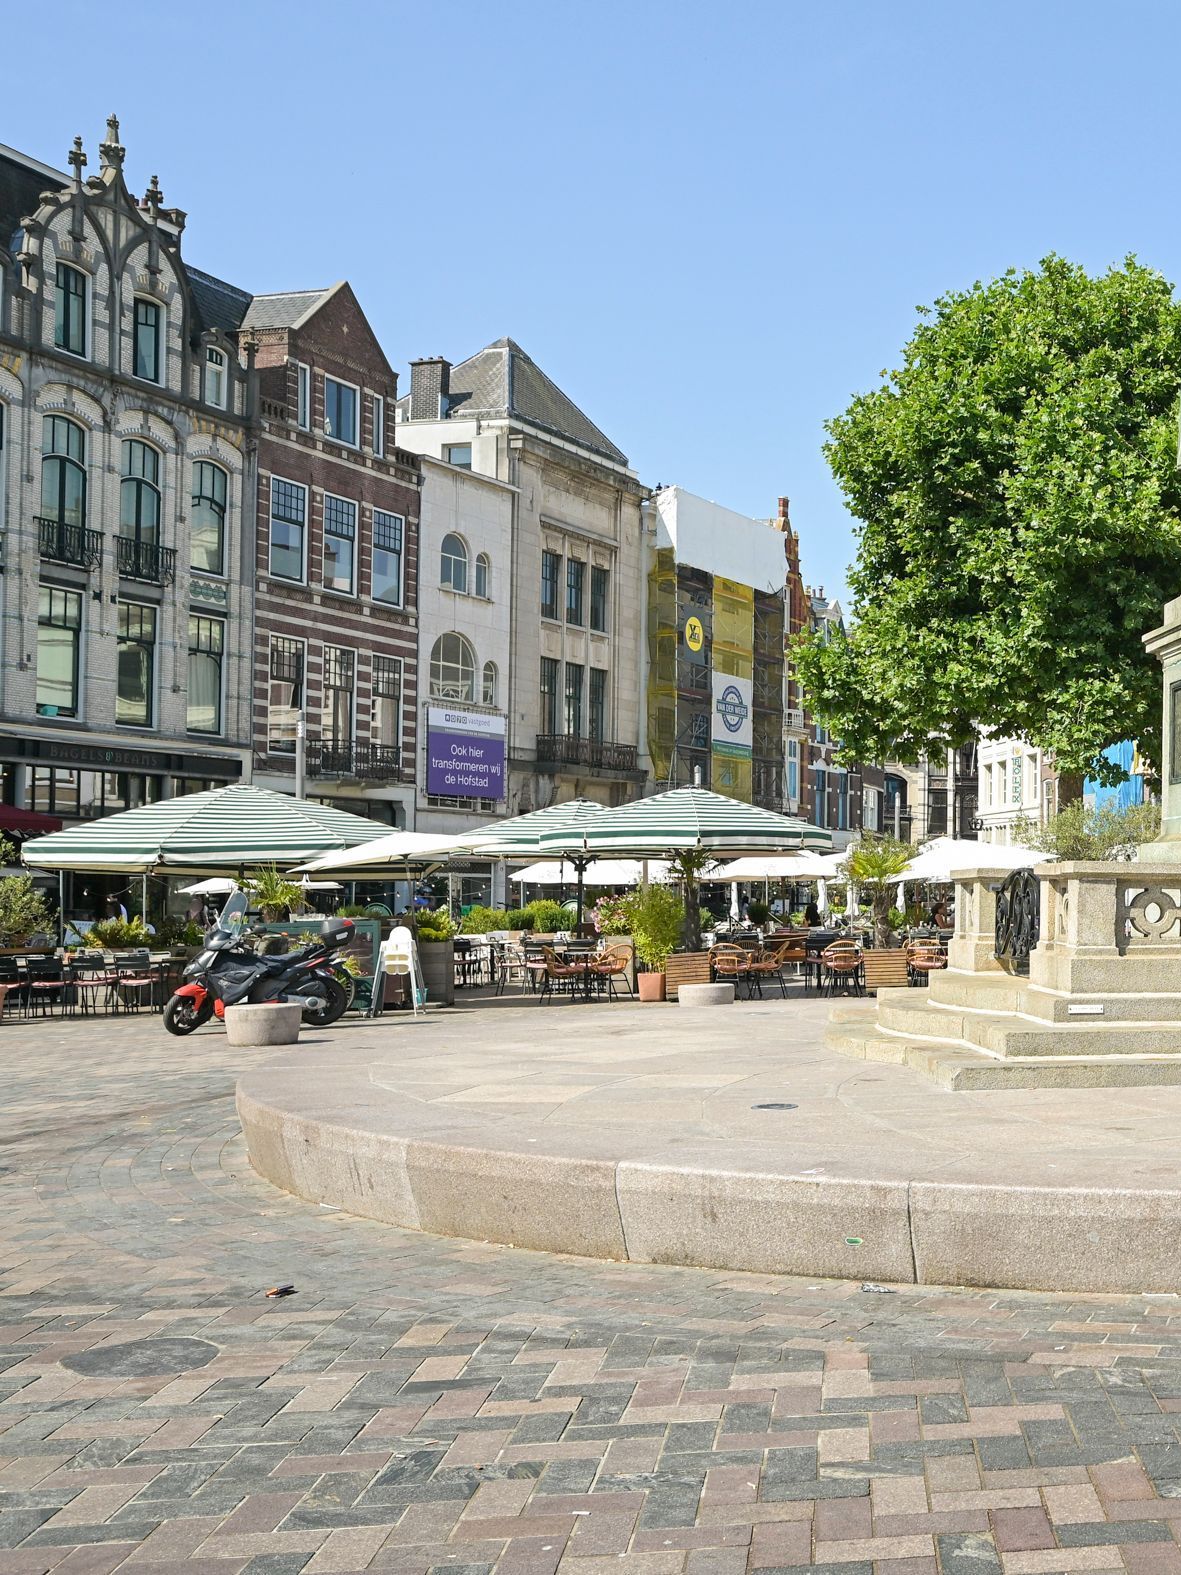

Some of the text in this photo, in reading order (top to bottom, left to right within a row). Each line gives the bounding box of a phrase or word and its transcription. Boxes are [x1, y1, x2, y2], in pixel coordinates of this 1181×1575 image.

[717, 702, 748, 716] VAN DER WEIDE
[49, 745, 106, 760] BAGELS
[115, 752, 159, 767] BEANS
[450, 744, 484, 758] Ook hier
[432, 757, 501, 776] transformeren wij
[444, 773, 489, 787] de Hofstad
[1012, 757, 1021, 804] ROLEX
